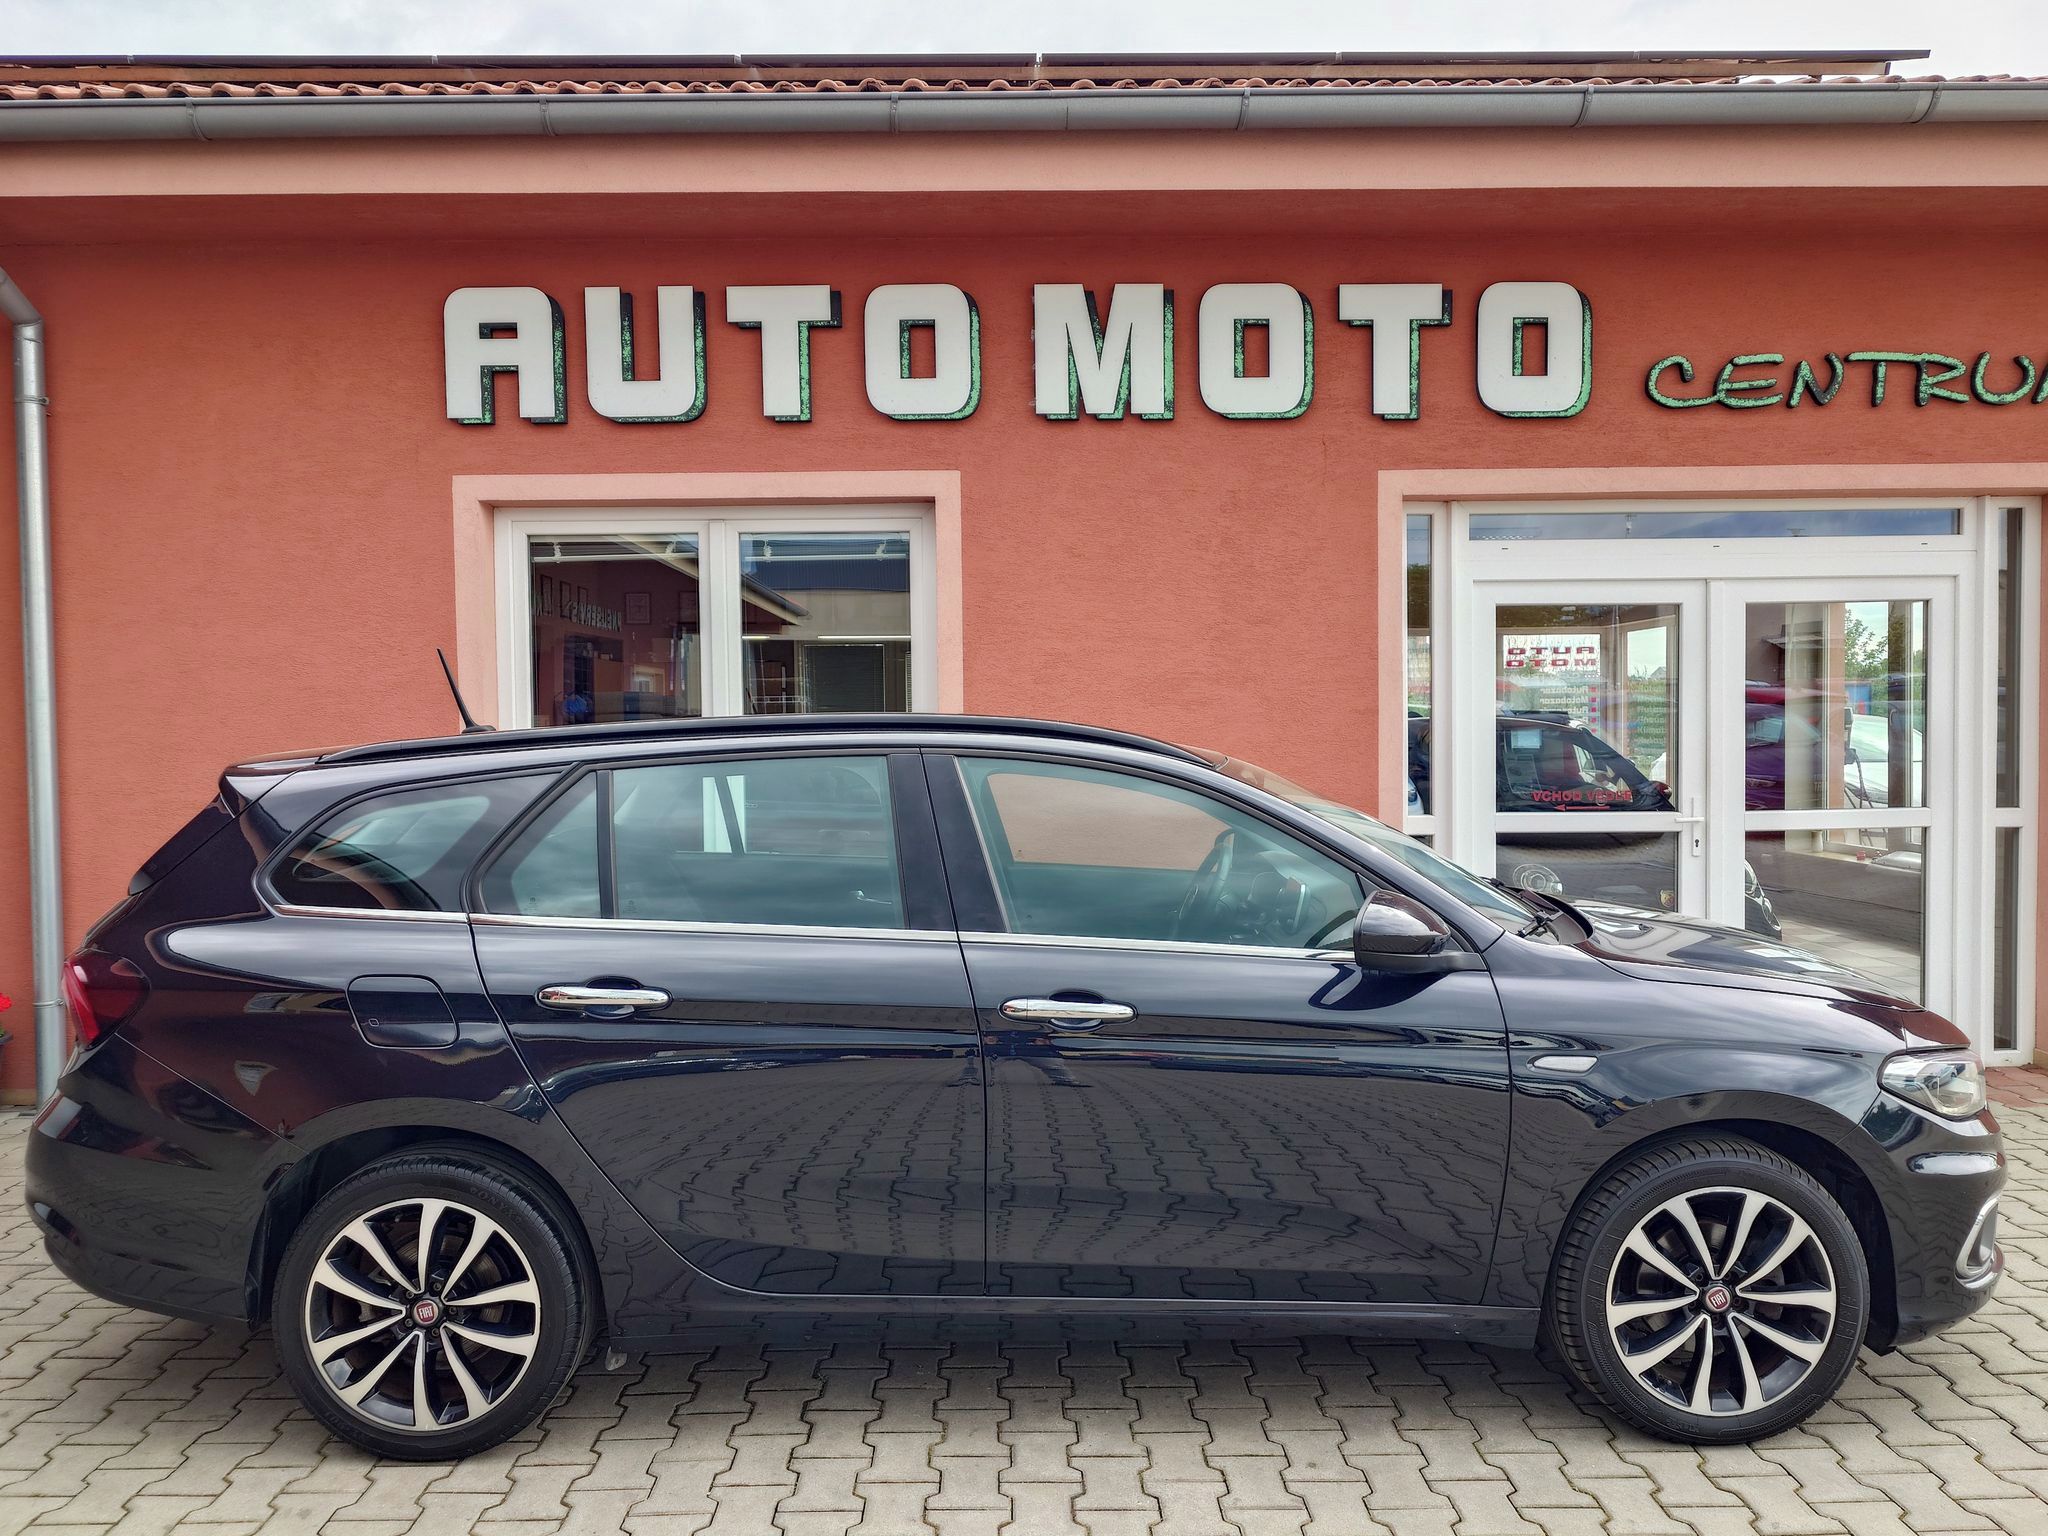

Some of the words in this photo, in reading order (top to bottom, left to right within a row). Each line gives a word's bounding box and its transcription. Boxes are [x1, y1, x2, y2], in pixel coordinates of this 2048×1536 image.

[443, 283, 981, 424] AUTO
[1033, 281, 1593, 420] MOTO
[1645, 351, 2048, 408] CENTRU
[1532, 790, 1582, 802] VCHOD
[1711, 1292, 1726, 1307] FIAT
[419, 1306, 433, 1319] FIAT
